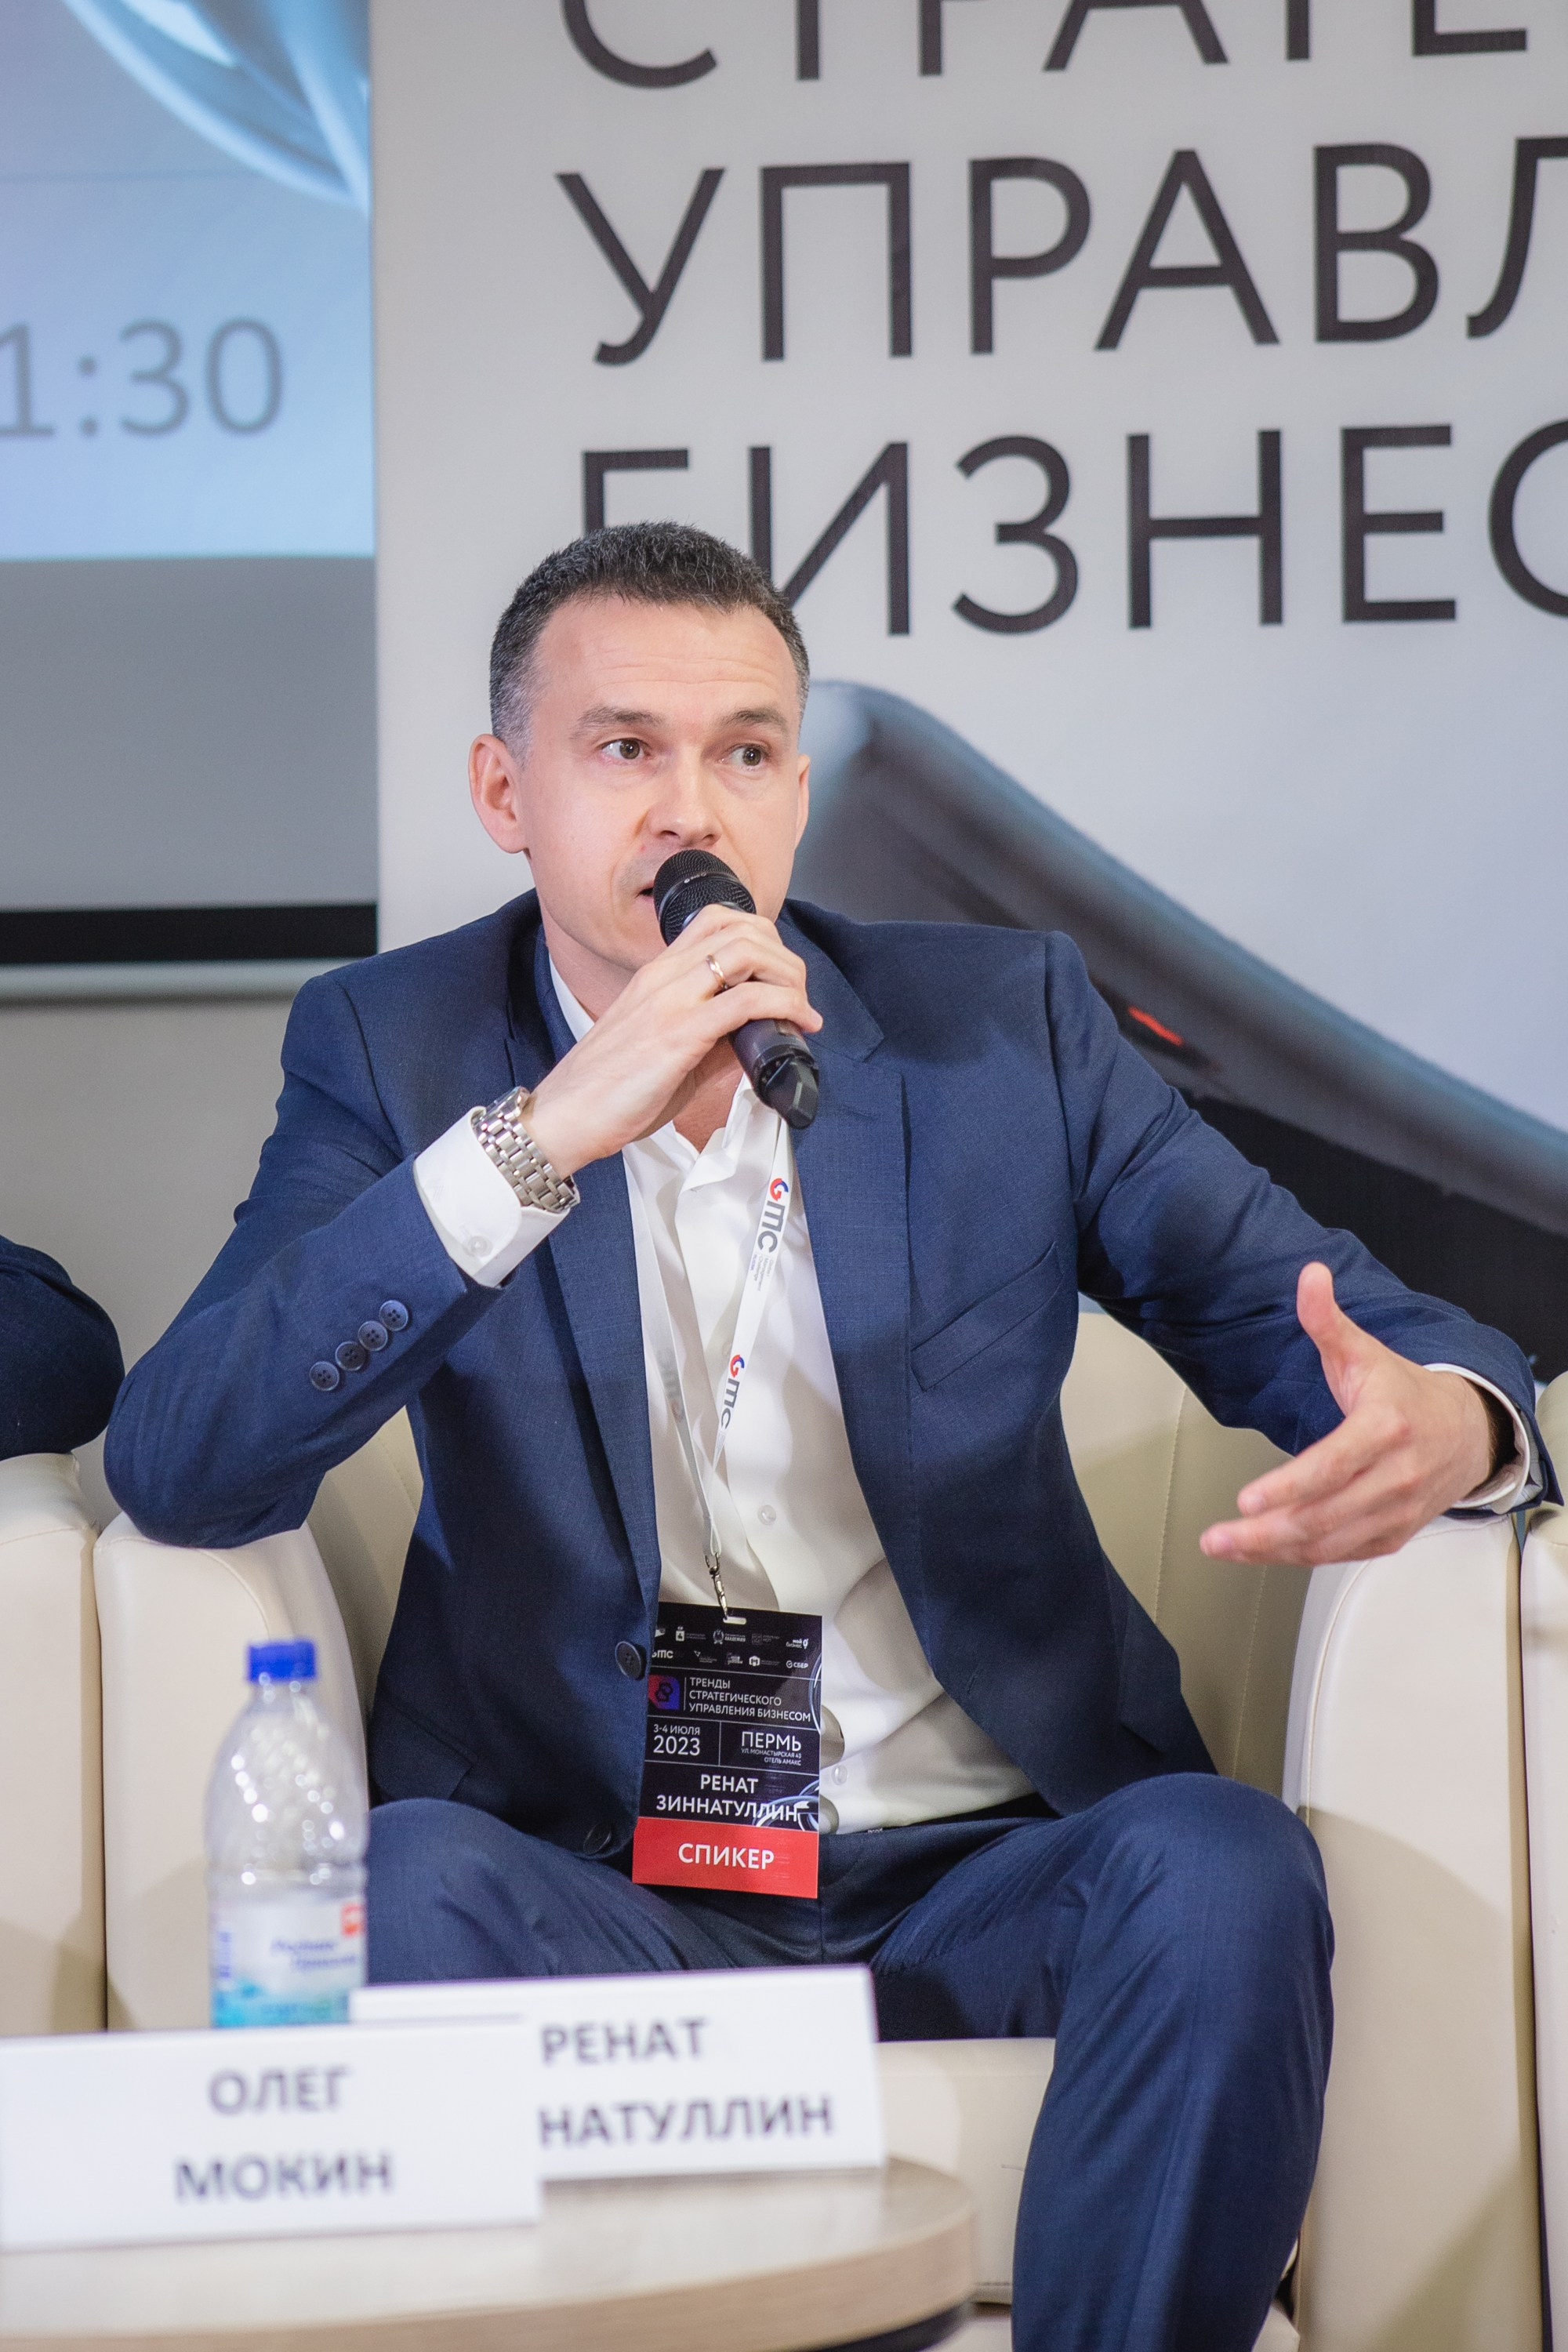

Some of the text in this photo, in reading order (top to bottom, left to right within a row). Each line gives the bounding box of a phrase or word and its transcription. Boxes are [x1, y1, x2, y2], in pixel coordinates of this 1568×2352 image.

[690, 1677, 731, 1689] ТРЕНДЫ
[689, 1690, 782, 1706] СТРАТЕГИЧЕСКОГО
[689, 1703, 811, 1722] УПРАВЛЕНИЯ БИЗНЕСОМ
[653, 1724, 700, 1735] 3-4 ИЮЛЯ
[653, 1735, 700, 1756] 2023
[742, 1731, 801, 1751] ПЕРМЬ
[700, 1773, 758, 1794] РЕНАТ
[656, 1795, 797, 1821] ЗИННАТУЛЛИН
[678, 1842, 774, 1870] СПИКЕР
[540, 2016, 707, 2065] РЕНАТ
[209, 2066, 349, 2116] ОЛЕГ
[538, 2096, 833, 2148] НАТУЛЛИН
[175, 2148, 391, 2201] МОКИН
